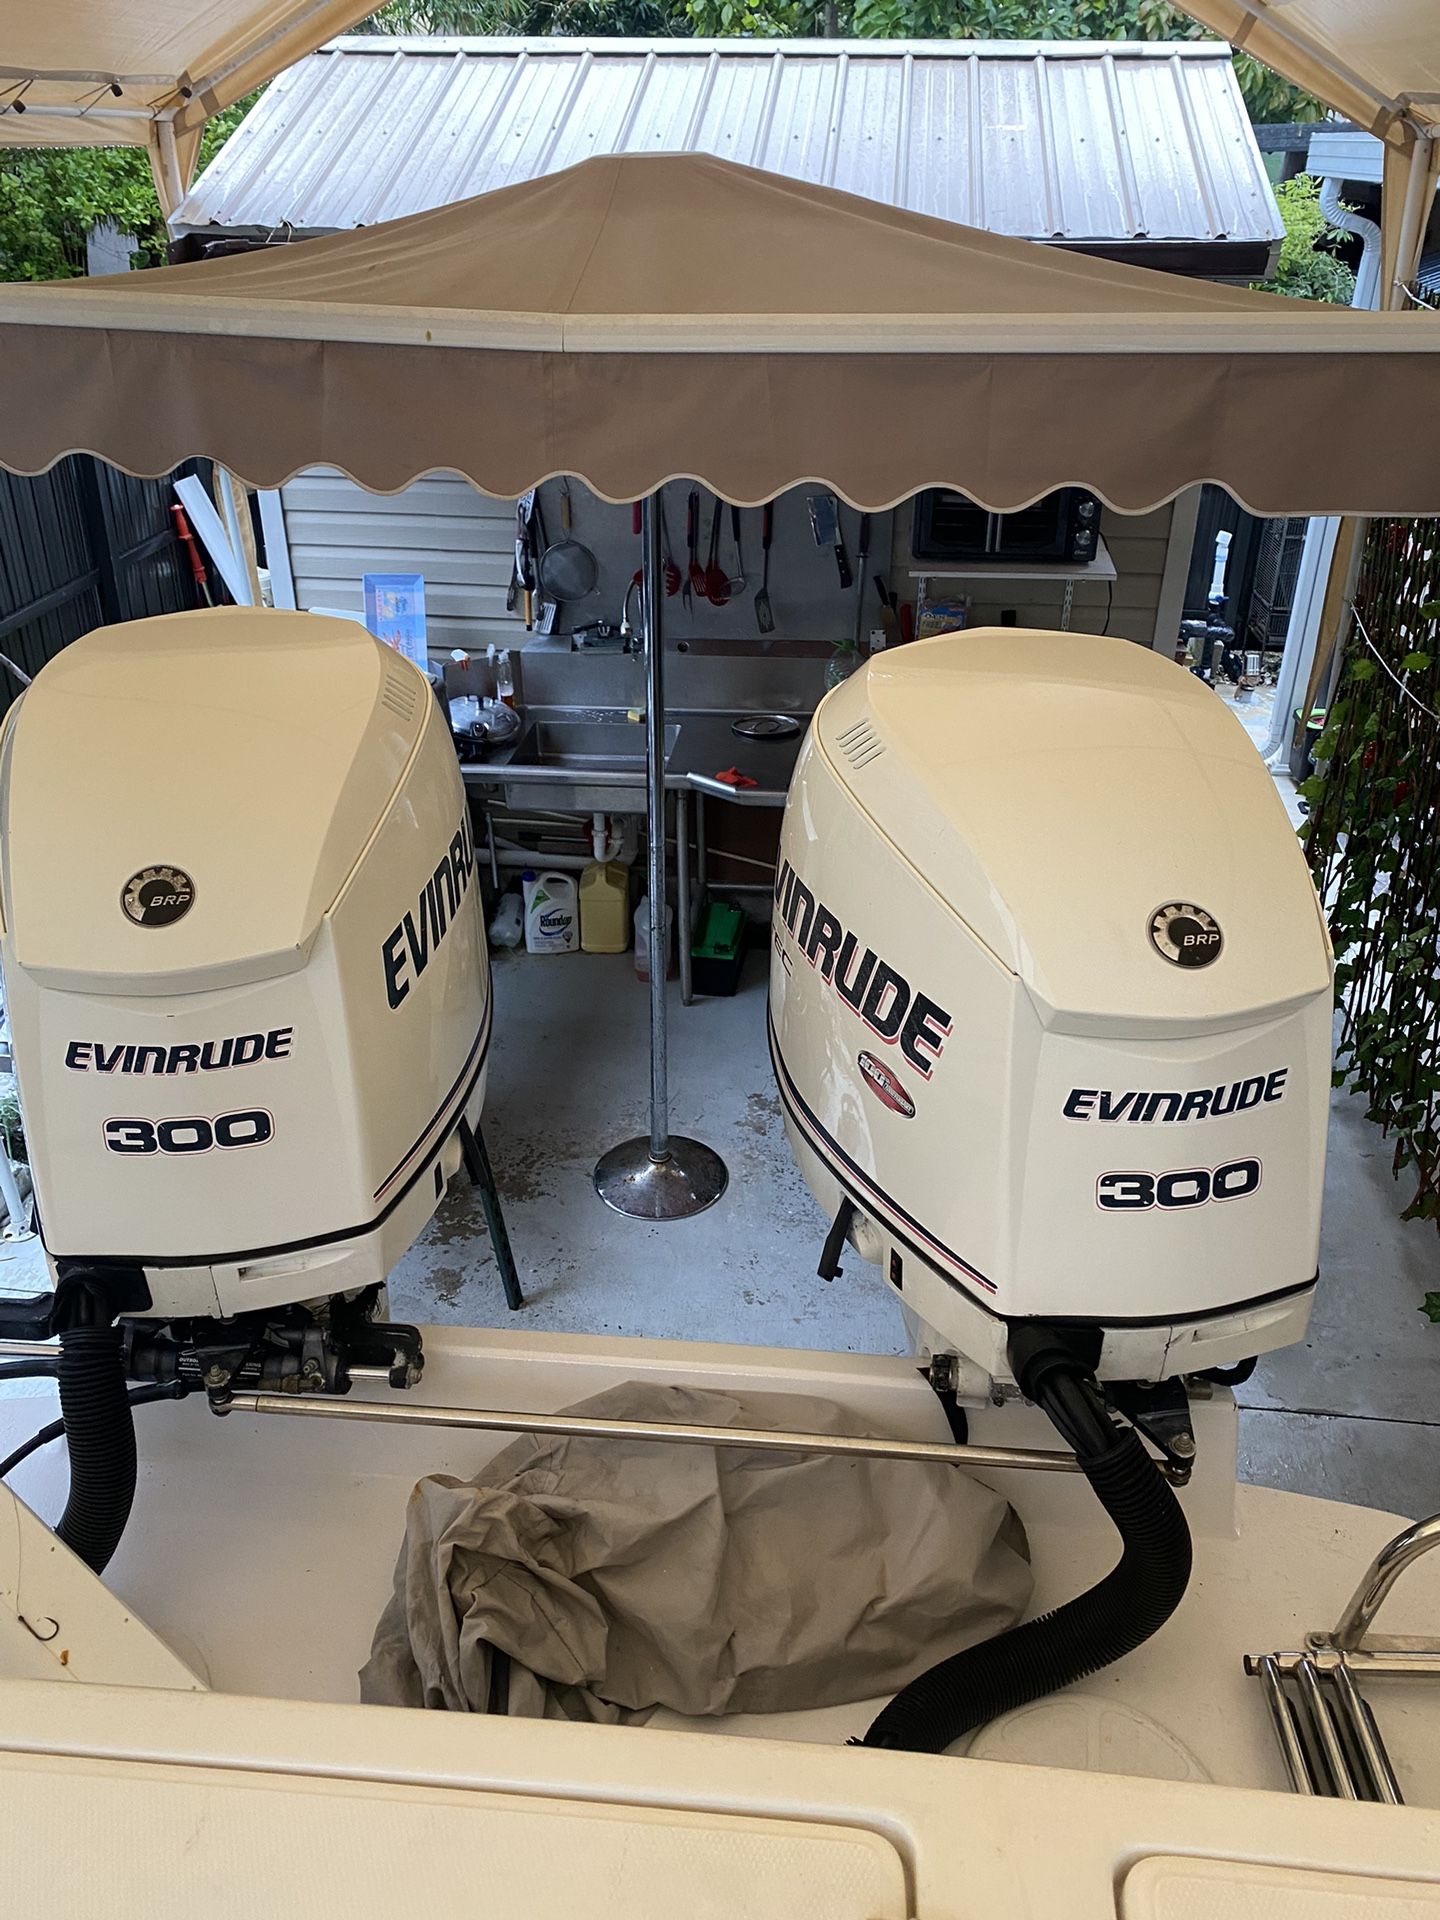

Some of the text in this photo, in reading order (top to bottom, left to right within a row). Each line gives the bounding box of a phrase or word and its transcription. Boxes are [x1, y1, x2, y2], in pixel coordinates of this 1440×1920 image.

[150, 894, 190, 907] BRP
[540, 915, 572, 928] Roundup
[773, 922, 793, 977] EC
[1183, 934, 1220, 946] BRP
[65, 1026, 293, 1076] EVINRUDE
[1062, 1068, 1289, 1123] EVINRUDE
[104, 1108, 274, 1155] 300
[1098, 1158, 1261, 1210] 300
